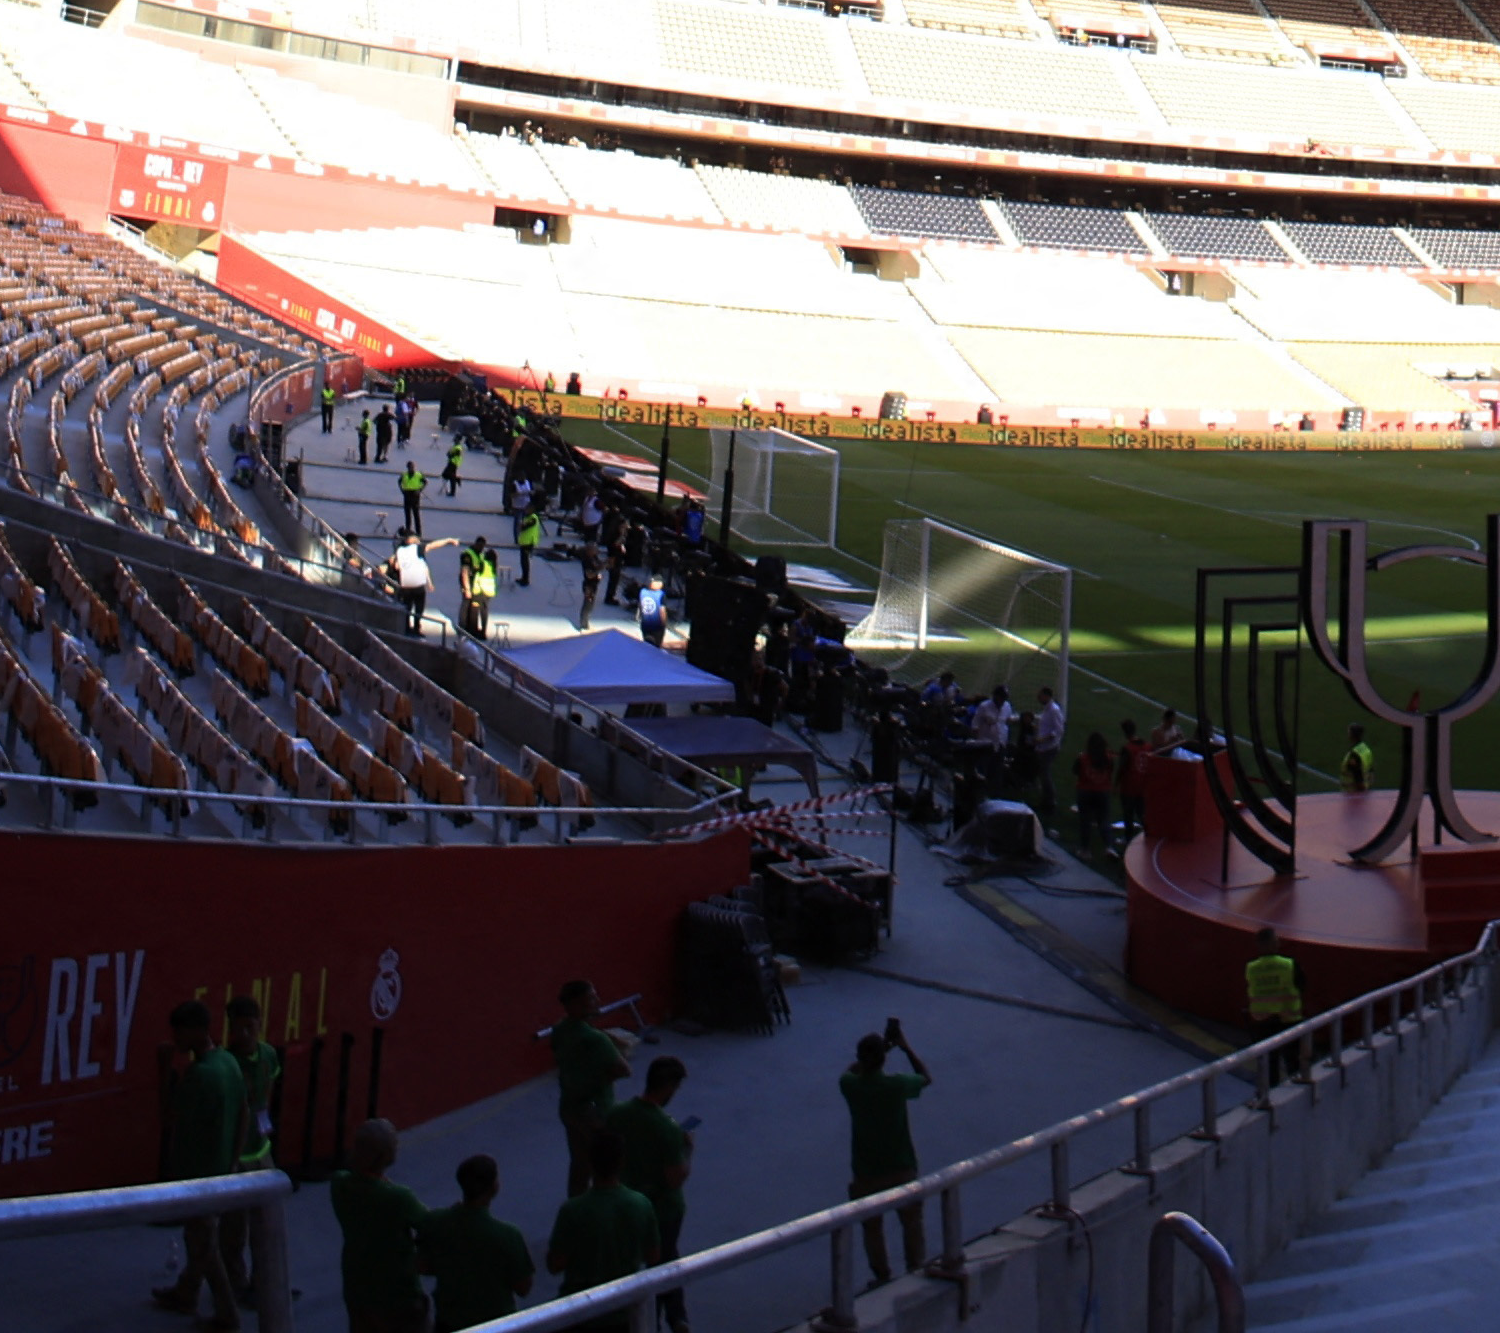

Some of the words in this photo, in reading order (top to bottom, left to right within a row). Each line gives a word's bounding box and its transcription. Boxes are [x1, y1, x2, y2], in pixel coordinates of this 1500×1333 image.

[598, 398, 699, 428] idealista
[732, 410, 831, 435] idealista
[862, 418, 956, 442] idealista
[987, 424, 1078, 447] idealista
[1108, 430, 1196, 450] idealista
[1223, 433, 1307, 451] idealista
[41, 949, 146, 1086] REY
